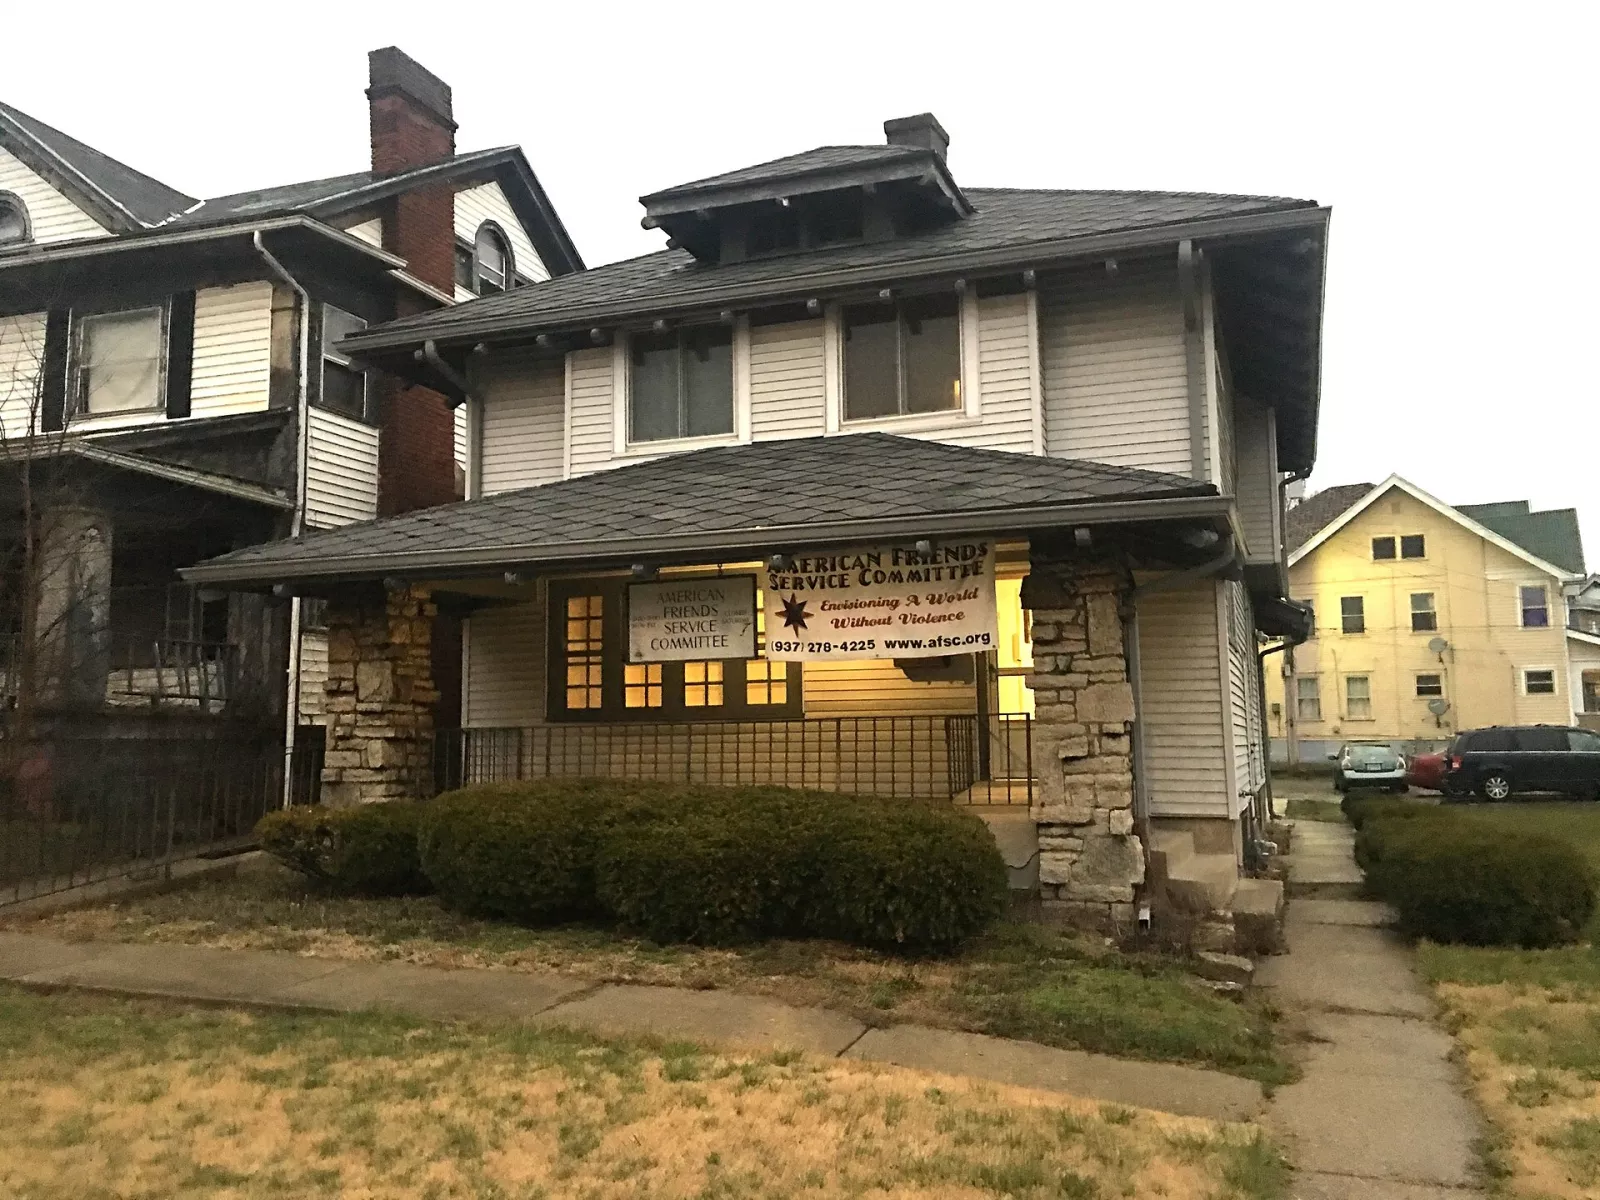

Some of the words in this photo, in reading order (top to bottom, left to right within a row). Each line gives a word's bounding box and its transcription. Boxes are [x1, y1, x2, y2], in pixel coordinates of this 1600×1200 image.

[891, 542, 989, 567] FRIENDS
[769, 573, 851, 591] SERVICE
[858, 560, 984, 587] COMMITTEE
[656, 589, 725, 604] AMERICAN
[820, 596, 900, 612] Envisioning
[905, 594, 921, 607] A
[925, 587, 979, 606] World
[663, 604, 719, 619] FRIENDS
[830, 616, 893, 630] Without
[898, 610, 966, 626] Violence
[664, 619, 718, 635] SERVICE
[650, 634, 729, 651] COMMITTEE
[770, 640, 805, 653] (937)
[807, 639, 876, 653] 278-4225
[884, 632, 992, 650] www.afsc.org
